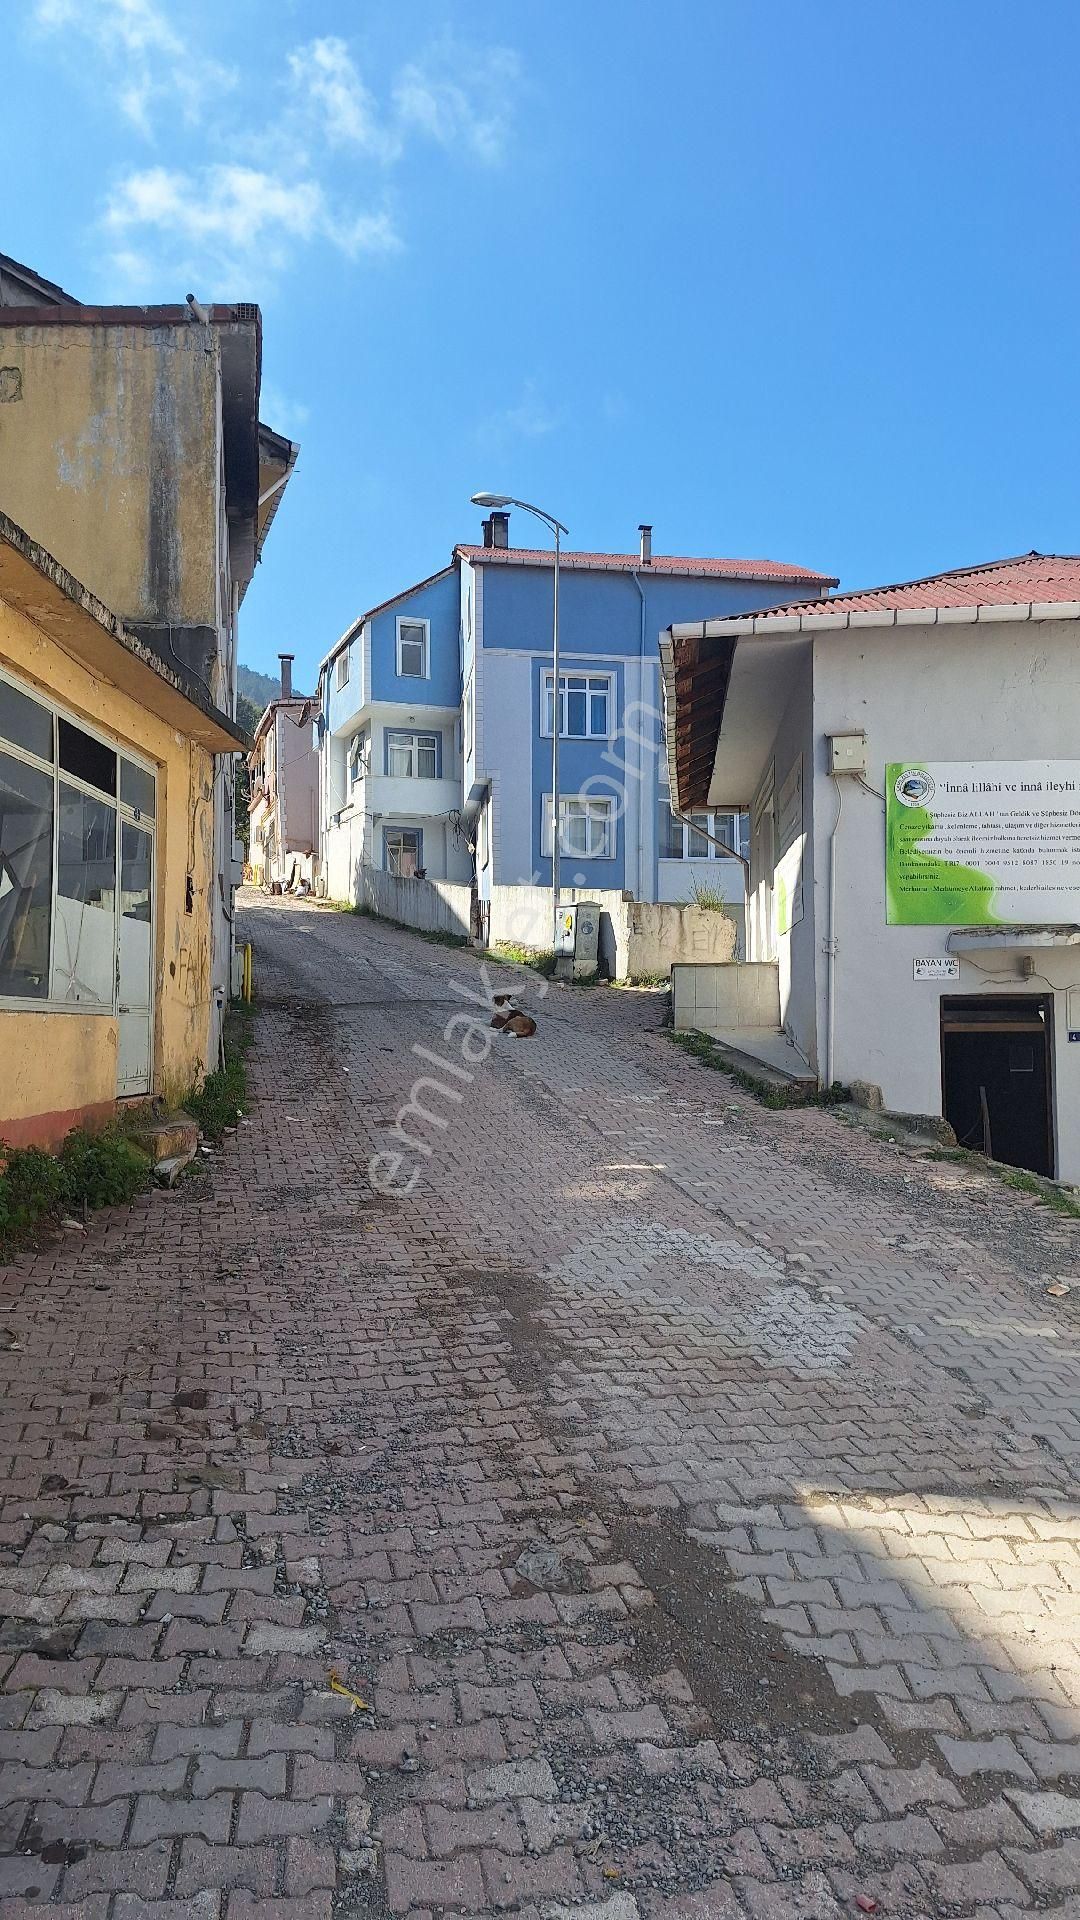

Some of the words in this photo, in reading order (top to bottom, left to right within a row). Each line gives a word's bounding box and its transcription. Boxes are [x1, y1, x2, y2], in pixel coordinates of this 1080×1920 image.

[1005, 783, 1016, 791] ve
[1047, 780, 1075, 792] ileyhi
[915, 959, 942, 967] BAYAN
[944, 959, 958, 967] WC
